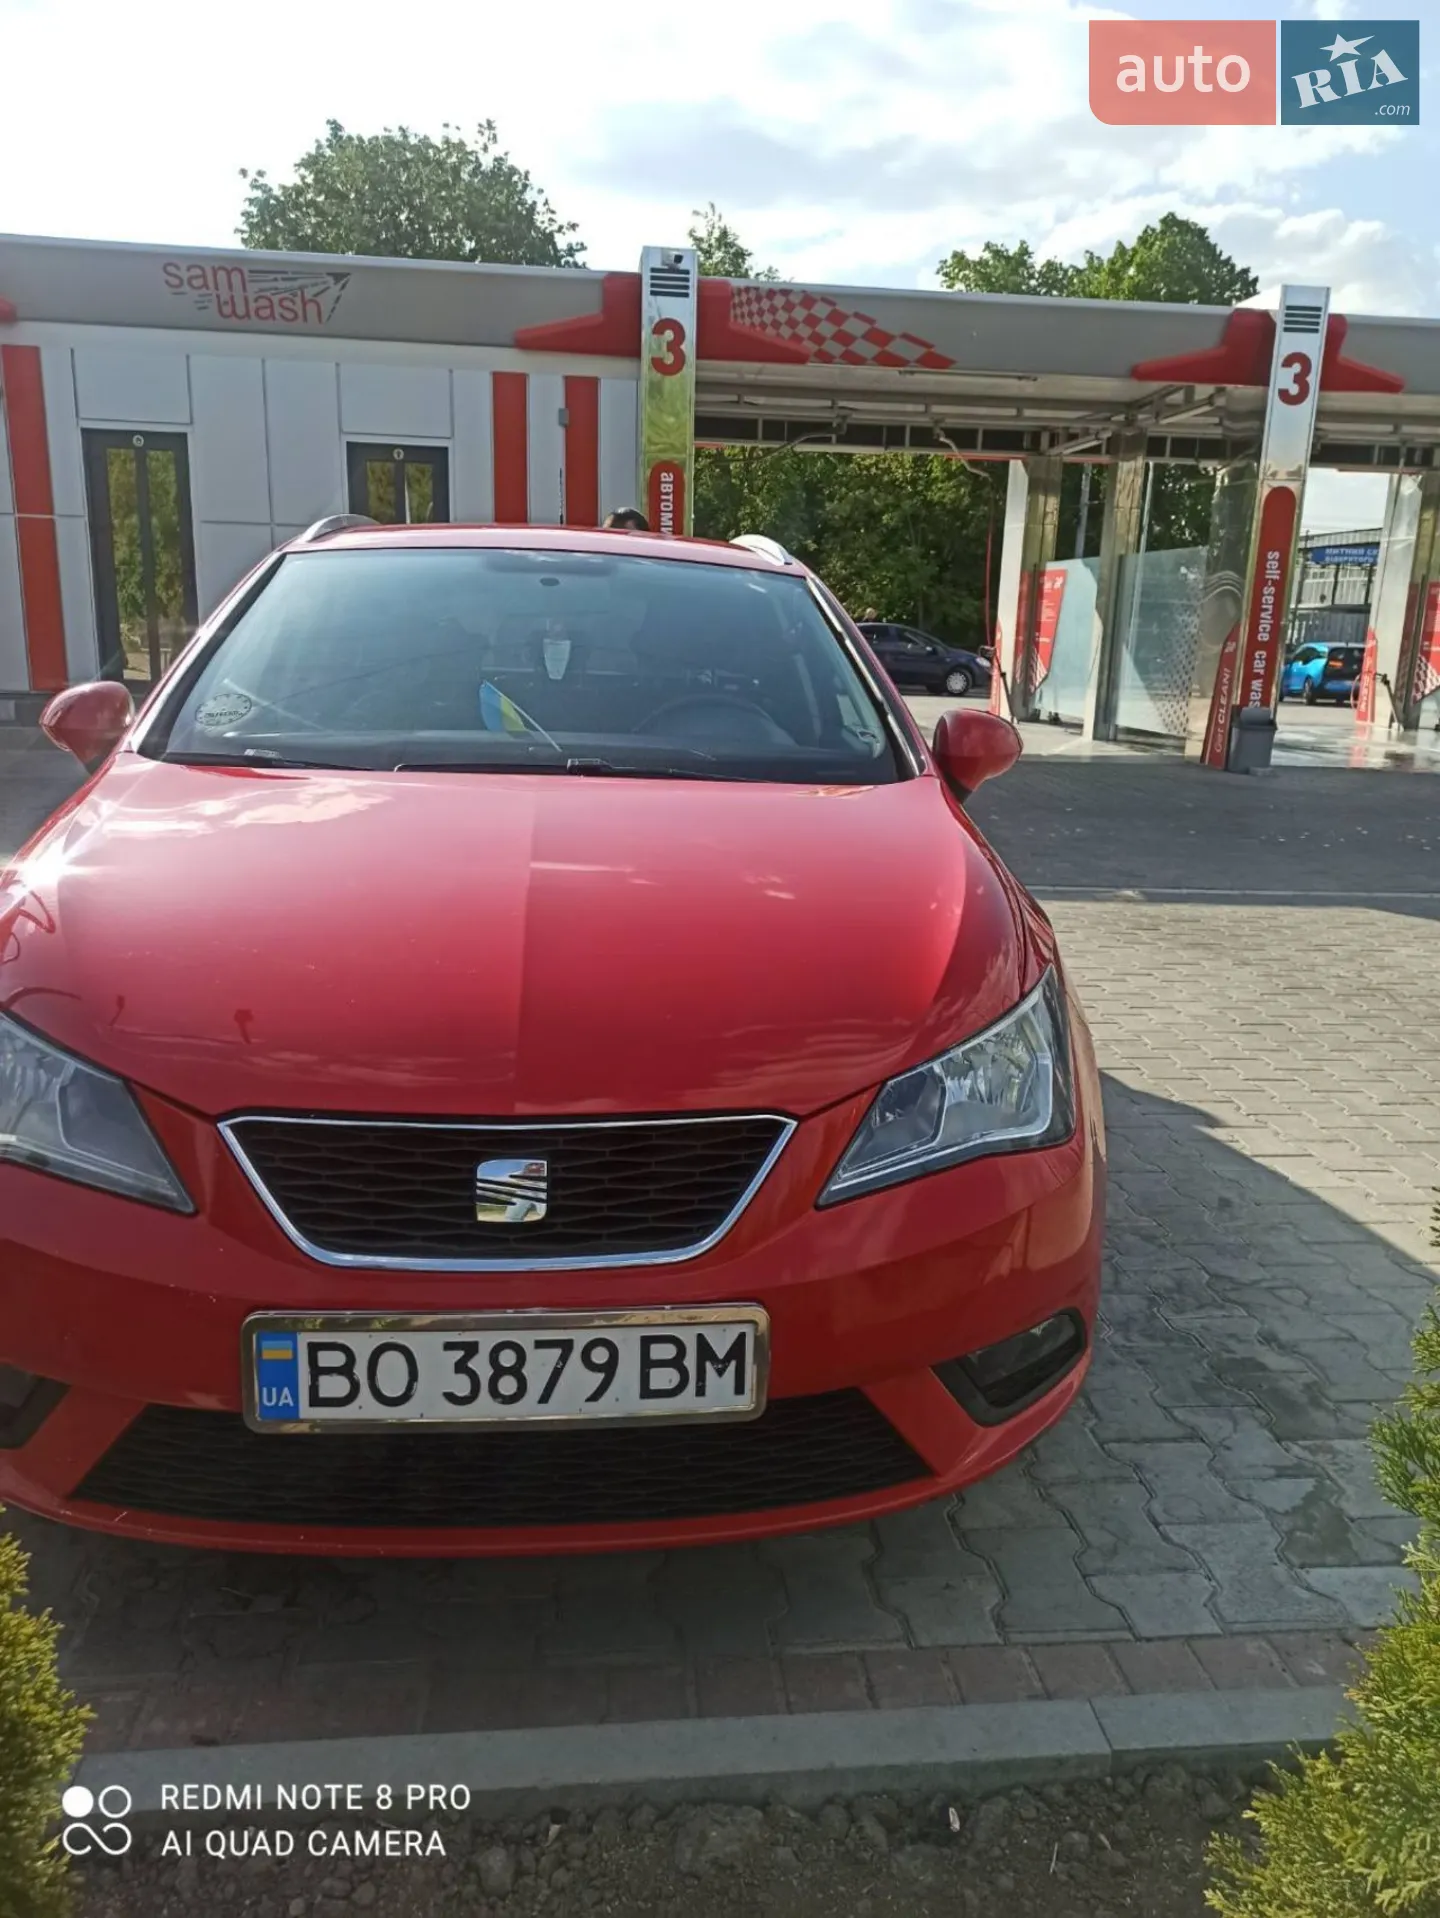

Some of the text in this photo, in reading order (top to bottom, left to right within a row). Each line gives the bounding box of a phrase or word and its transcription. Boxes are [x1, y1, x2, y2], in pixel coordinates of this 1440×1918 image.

[162, 262, 247, 293] sam
[215, 284, 323, 325] wash
[651, 318, 686, 377] 3
[1277, 351, 1313, 406] 3
[1257, 550, 1281, 642] self-service
[1253, 650, 1268, 676] car
[441, 1337, 620, 1406] 3879
[262, 1386, 295, 1408] UA
